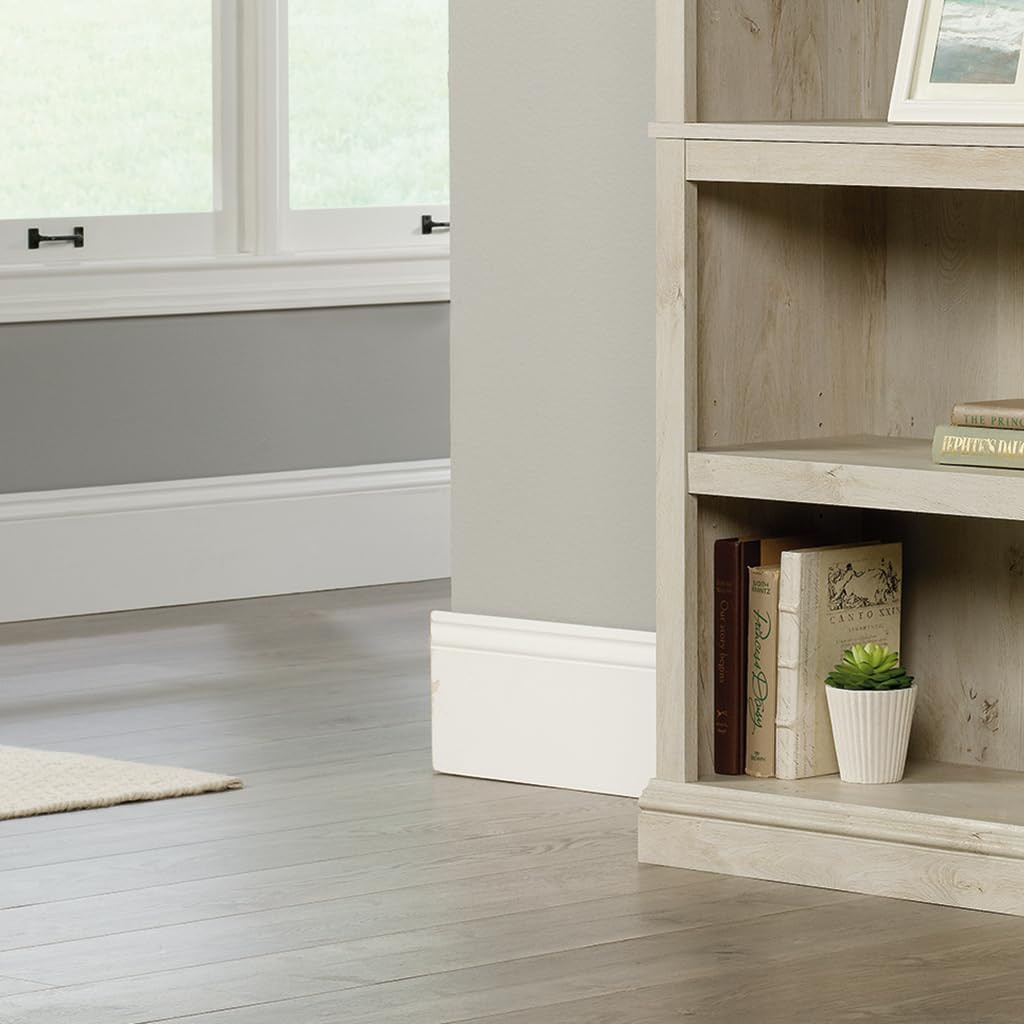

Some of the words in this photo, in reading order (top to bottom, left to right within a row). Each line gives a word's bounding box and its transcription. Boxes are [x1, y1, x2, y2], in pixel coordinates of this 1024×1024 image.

[963, 414, 986, 425] THE
[829, 610, 873, 624] CANTO
[752, 609, 771, 669] Princess
[749, 671, 769, 735] Daisy
